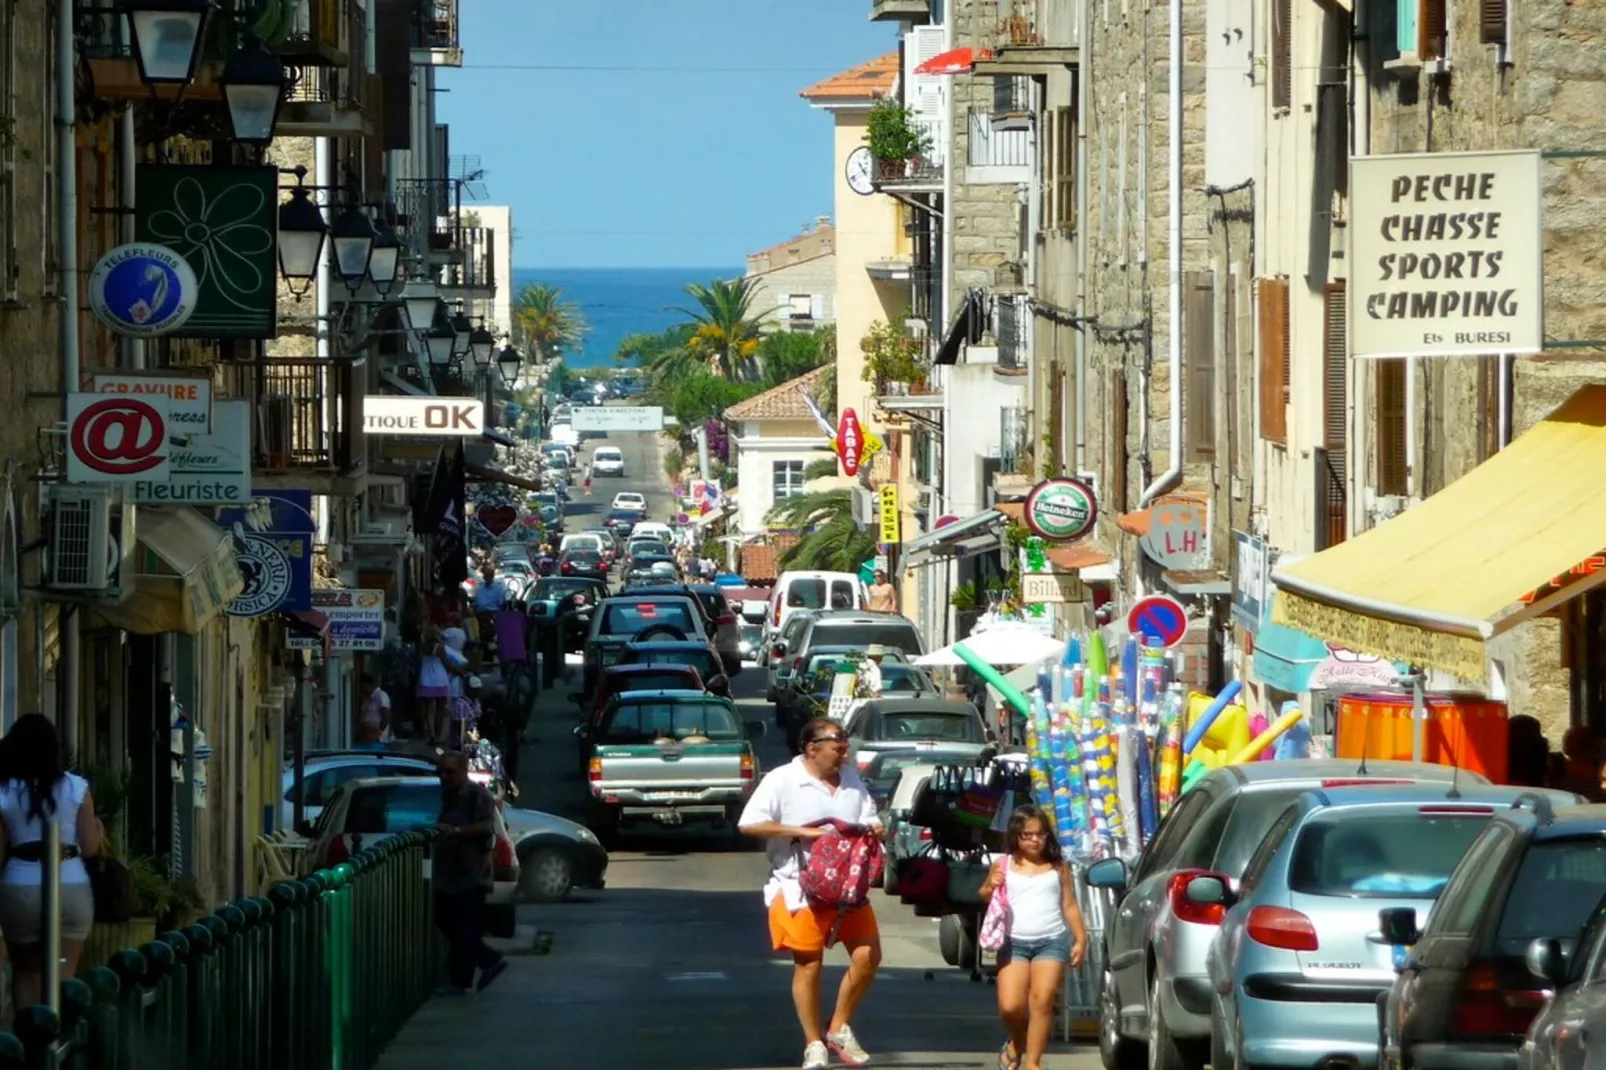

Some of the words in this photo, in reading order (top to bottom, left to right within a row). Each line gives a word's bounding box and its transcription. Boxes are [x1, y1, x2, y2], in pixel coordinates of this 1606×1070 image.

[1391, 173, 1495, 203] PECHE
[1380, 212, 1502, 241] CHASSE
[1378, 250, 1503, 281] SPORTS
[1366, 289, 1518, 319] CAMPING
[1423, 333, 1443, 344] Ets
[1455, 332, 1511, 343] BURESI
[102, 382, 198, 400] GRAVURE
[169, 412, 206, 423] ress
[363, 415, 418, 428] TIQUE
[425, 405, 476, 429] OK
[844, 417, 857, 468] TABAC
[135, 480, 239, 500] Fleuriste
[1036, 502, 1085, 519] Heineken
[1028, 580, 1077, 597] Billard
[228, 591, 277, 612] RSICA
